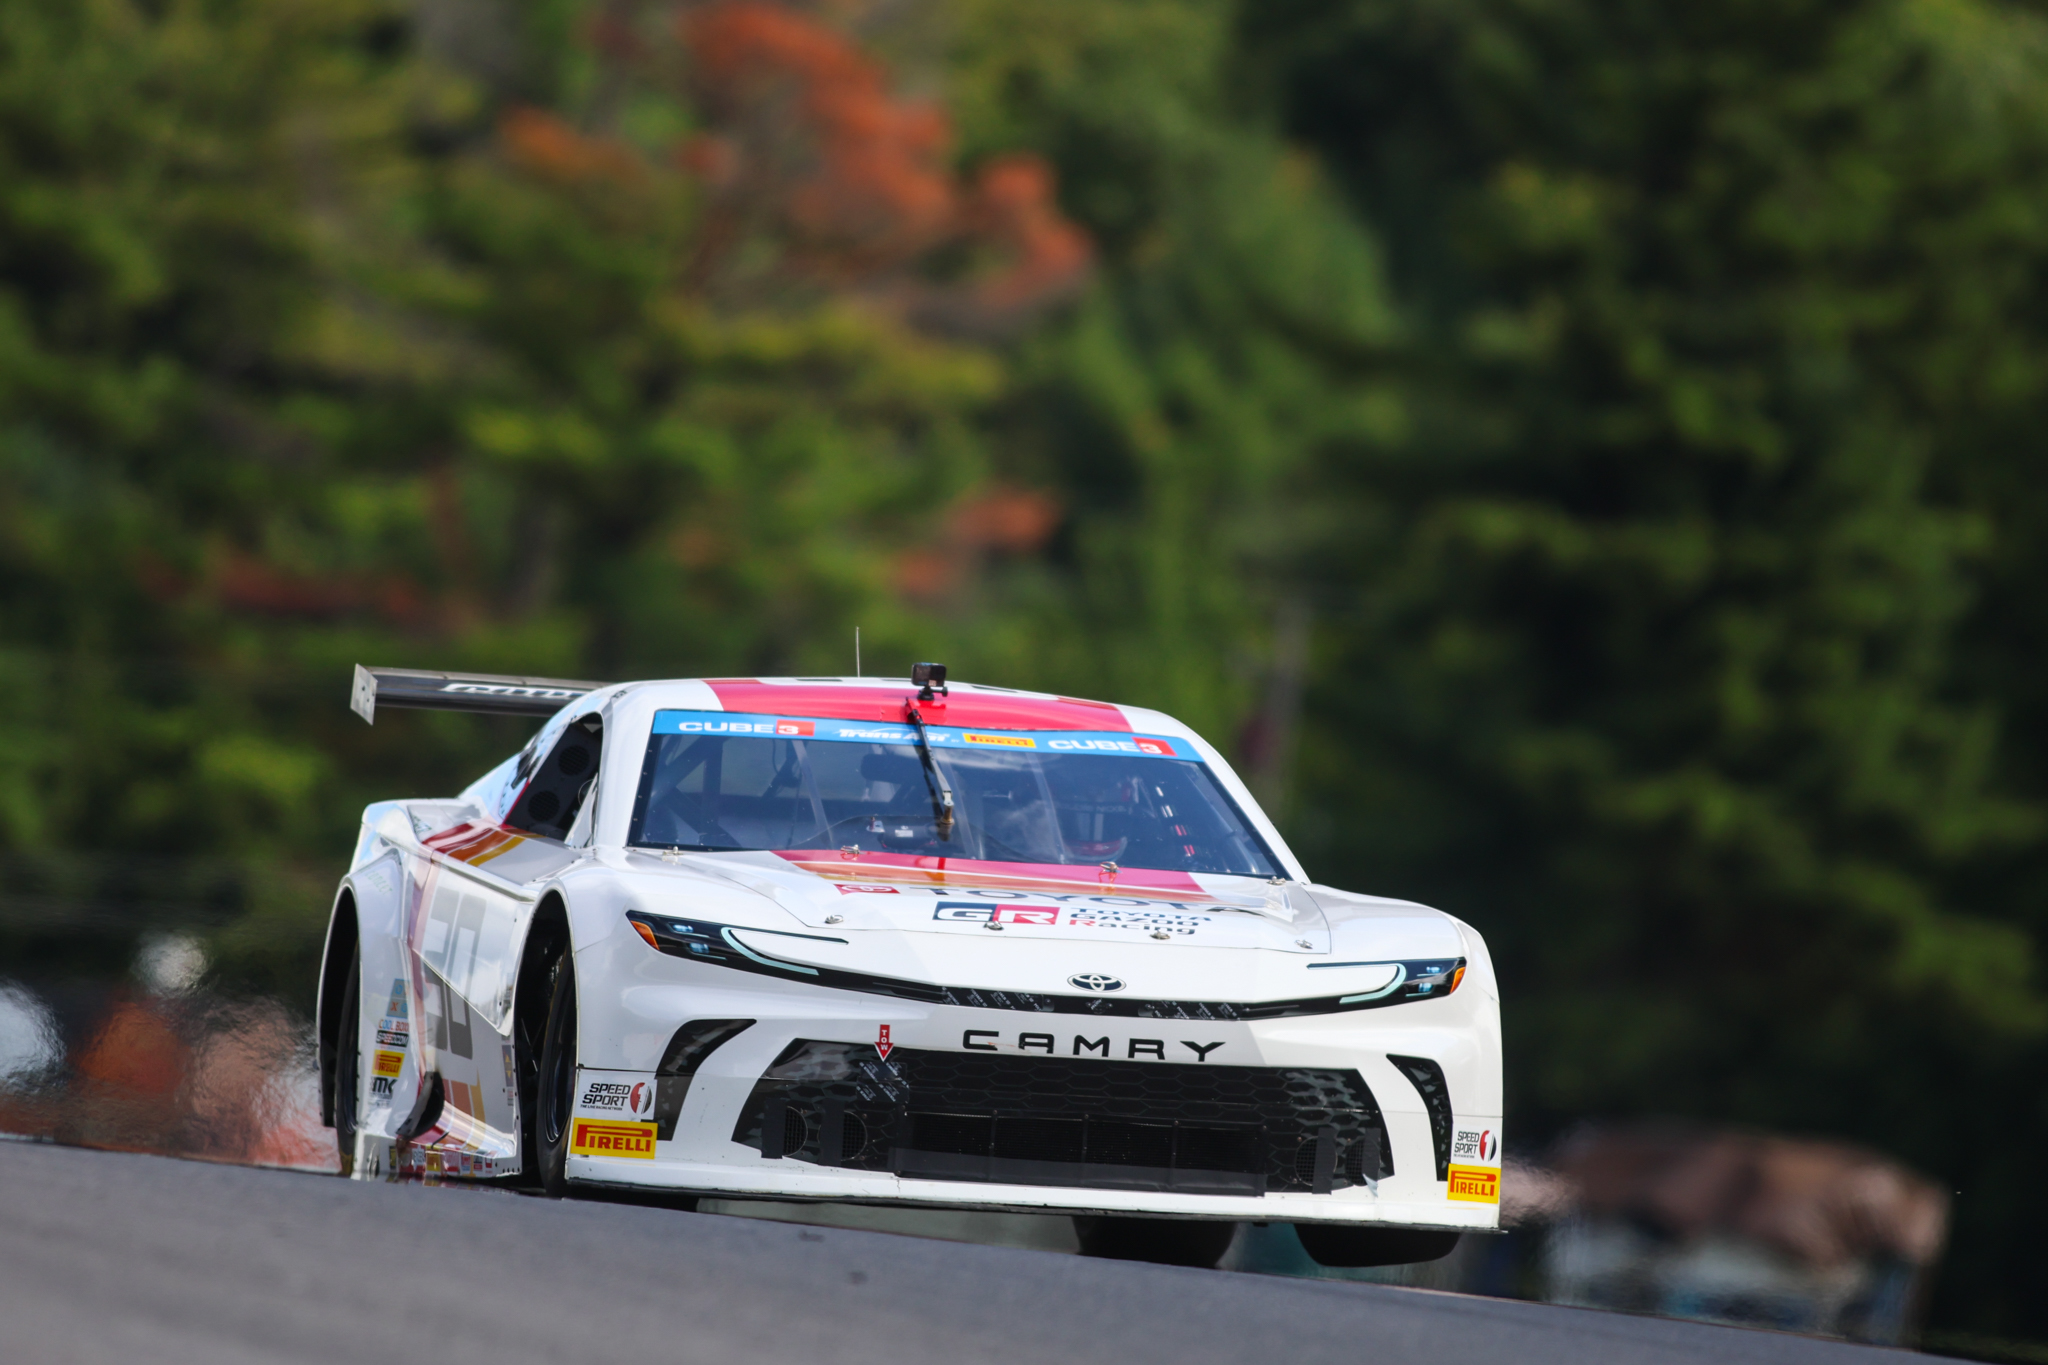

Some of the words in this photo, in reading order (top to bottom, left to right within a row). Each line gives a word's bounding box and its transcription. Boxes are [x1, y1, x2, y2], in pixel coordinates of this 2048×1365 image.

[969, 735, 1028, 746] PIRELLI
[936, 906, 1057, 925] GR
[1070, 908, 1212, 921] TOYOTA
[1070, 913, 1200, 926] GAZOO
[1069, 919, 1196, 935] Racing
[880, 1029, 888, 1051] TOW
[963, 1028, 1227, 1063] CAMRY
[375, 1054, 402, 1073] PIRELLI
[589, 1083, 631, 1095] SPEED
[582, 1094, 628, 1106] SPORT
[576, 1124, 653, 1152] PIRELLI
[1457, 1131, 1480, 1142] SPEED
[1454, 1143, 1478, 1154] SPORT
[1450, 1170, 1497, 1196] PIRELLI
